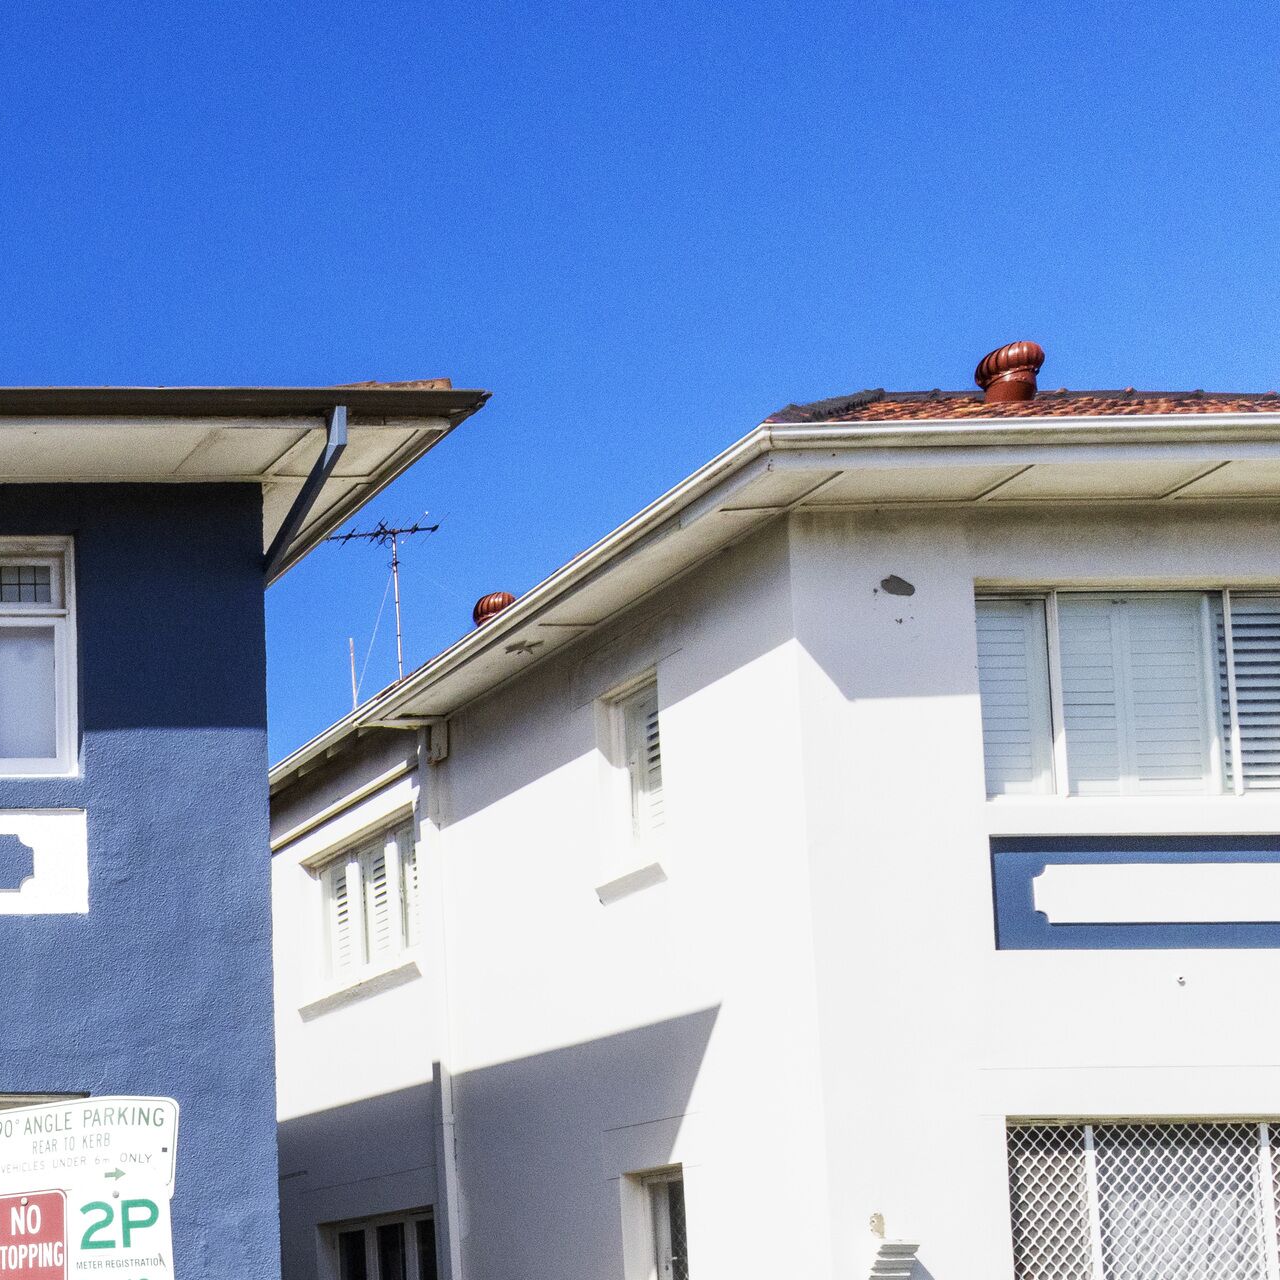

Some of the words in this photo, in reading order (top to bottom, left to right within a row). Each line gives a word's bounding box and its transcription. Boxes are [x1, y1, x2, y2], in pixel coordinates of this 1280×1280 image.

[23, 1111, 72, 1135] ANGLE
[83, 1107, 165, 1128] PARKING
[32, 1138, 57, 1154] REAR
[64, 1136, 75, 1151] TO
[82, 1132, 111, 1149] KERB
[1, 1160, 46, 1174] VEHICLES
[52, 1156, 87, 1168] UNDER
[119, 1152, 152, 1164] ONLY
[10, 1204, 42, 1236] NO
[79, 1198, 159, 1250] 2P
[76, 1260, 103, 1270] METER
